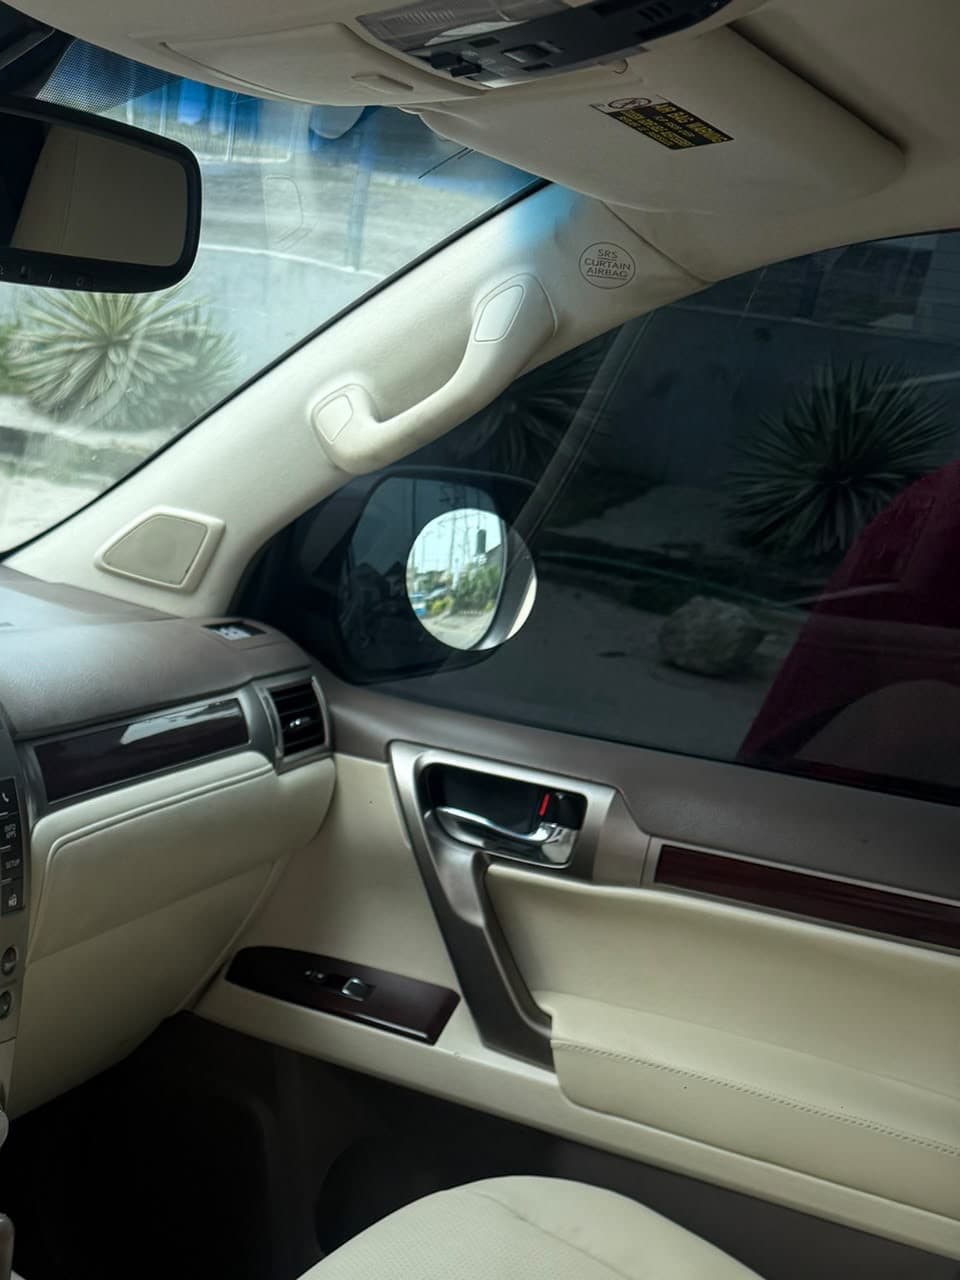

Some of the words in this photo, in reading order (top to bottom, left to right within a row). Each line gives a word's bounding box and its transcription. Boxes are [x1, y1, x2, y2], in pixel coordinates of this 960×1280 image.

[598, 249, 618, 258] SRS
[584, 258, 631, 270] CURTAIN
[586, 267, 629, 277] AIRBAG
